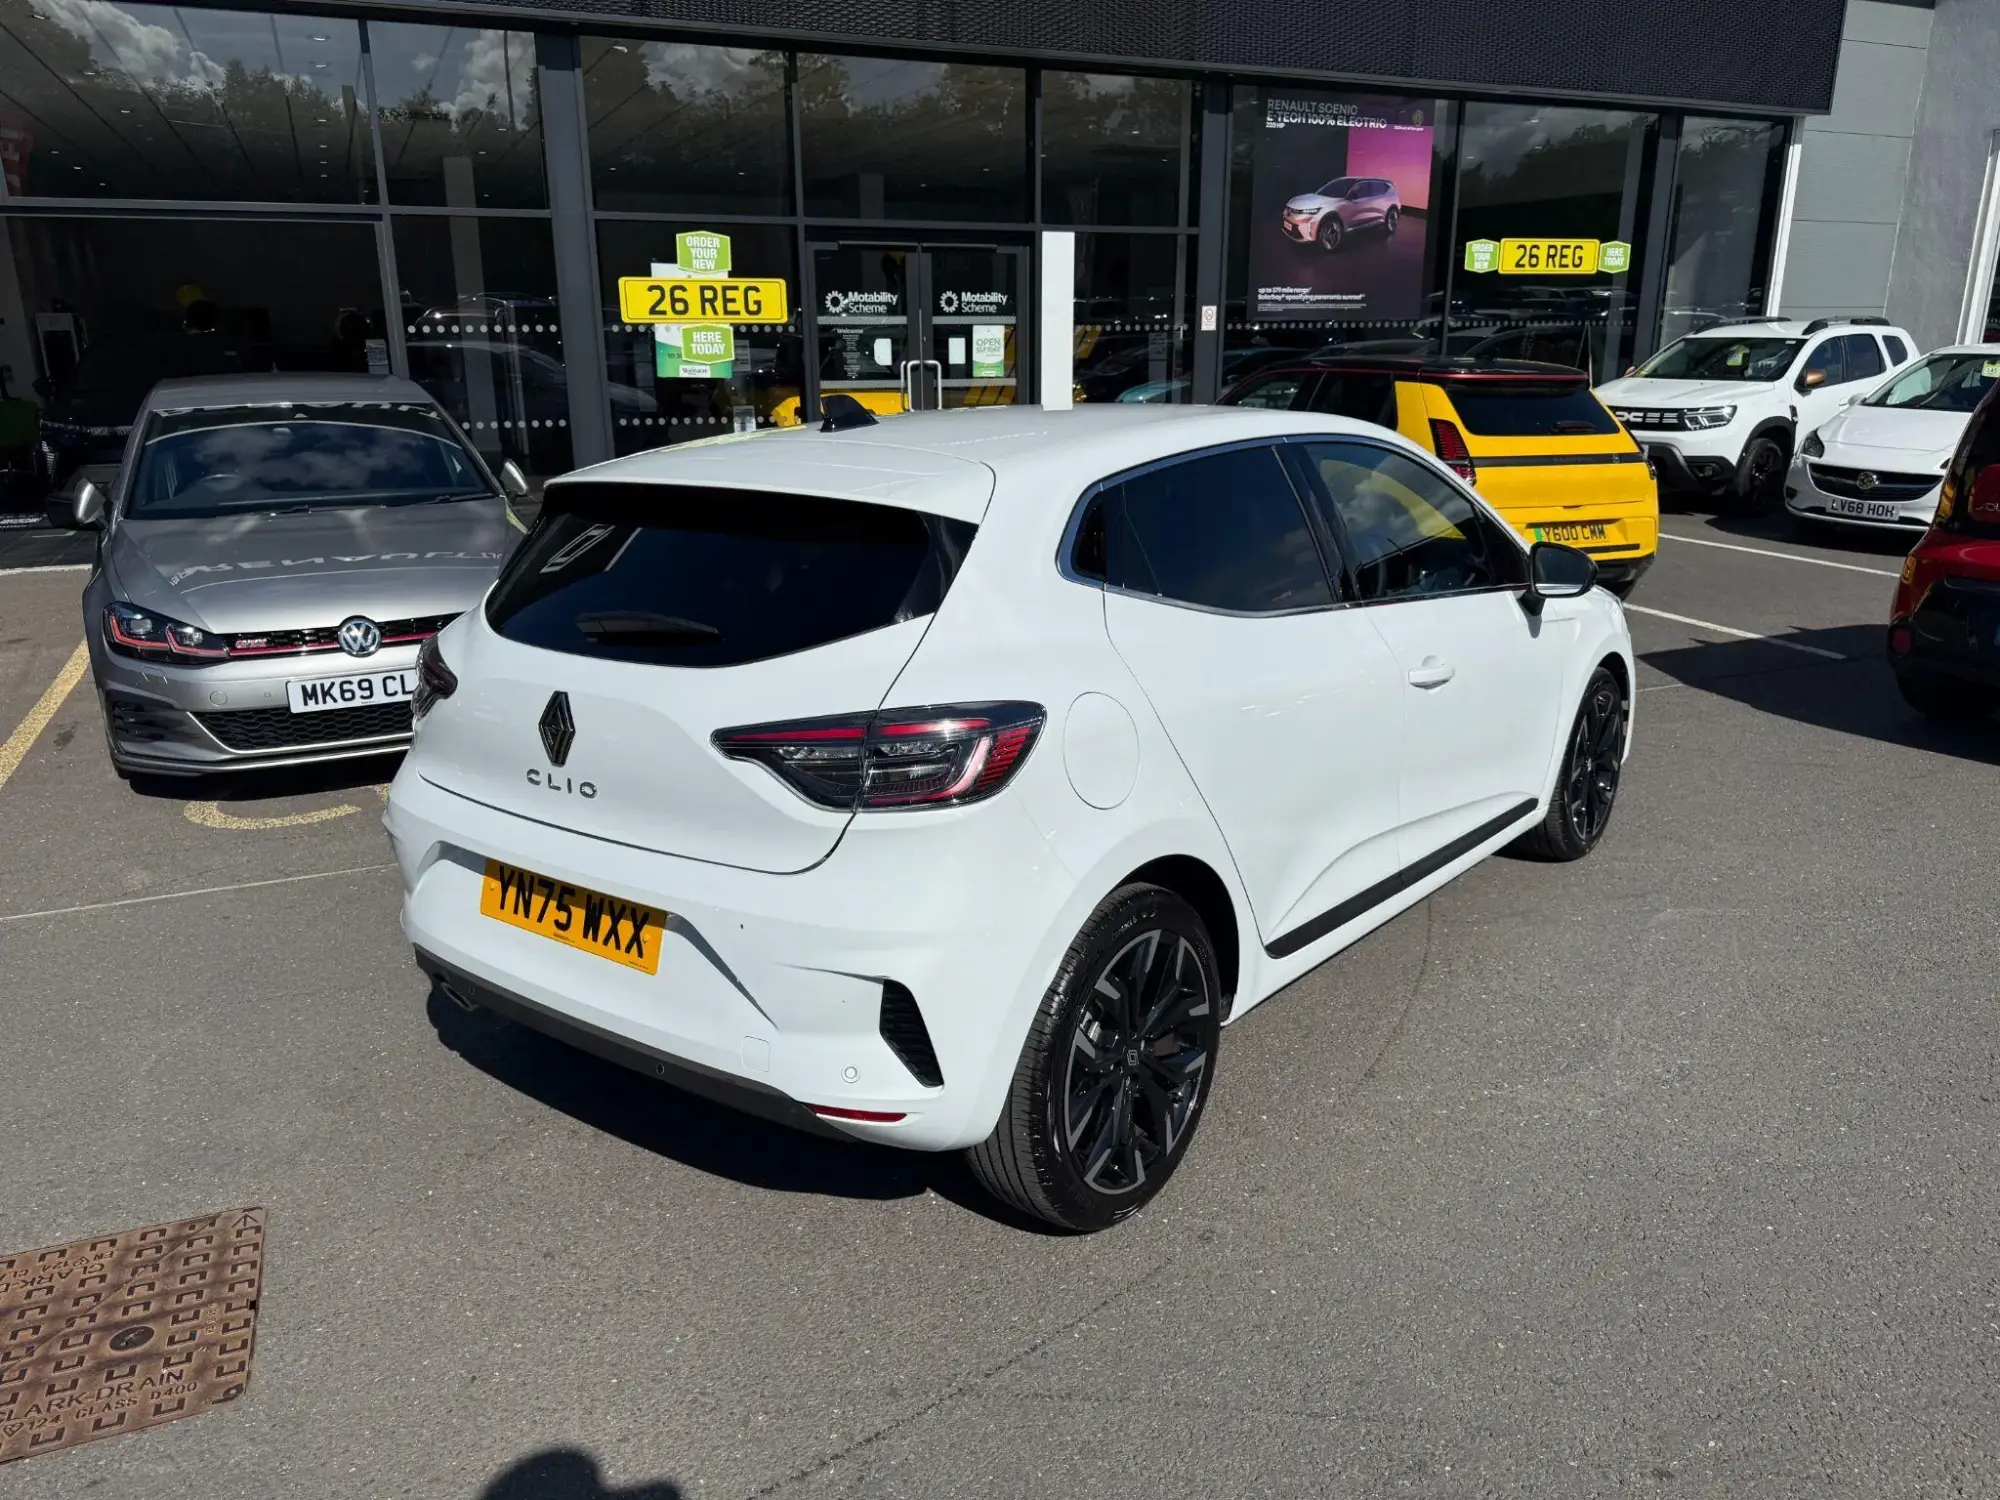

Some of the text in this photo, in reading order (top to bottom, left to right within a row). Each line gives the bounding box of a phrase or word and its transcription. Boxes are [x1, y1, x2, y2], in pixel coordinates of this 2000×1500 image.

[1267, 99, 1358, 115] RENAULT SCENIC
[1266, 111, 1306, 124] E-TECH
[1308, 114, 1336, 126] 100%
[1336, 116, 1388, 129] ELECTRIC
[686, 236, 720, 248] ORDER
[690, 248, 718, 259] YOUR
[1514, 244, 1584, 268] 26 REG
[692, 258, 716, 270] NEW
[647, 284, 762, 316] 26 REG
[848, 291, 898, 305] Motability
[961, 291, 1008, 305] Motability
[849, 303, 887, 313] Scheme
[962, 303, 997, 313] Scheme
[692, 331, 722, 343] HERE
[975, 338, 1001, 347] OPEN
[690, 342, 726, 355] TODAY
[301, 677, 374, 707] MK69
[526, 768, 598, 799] CLIO
[498, 865, 650, 960] YN75 WXX
[75, 1397, 138, 1420] CLASS
[150, 1382, 197, 1401] D400
